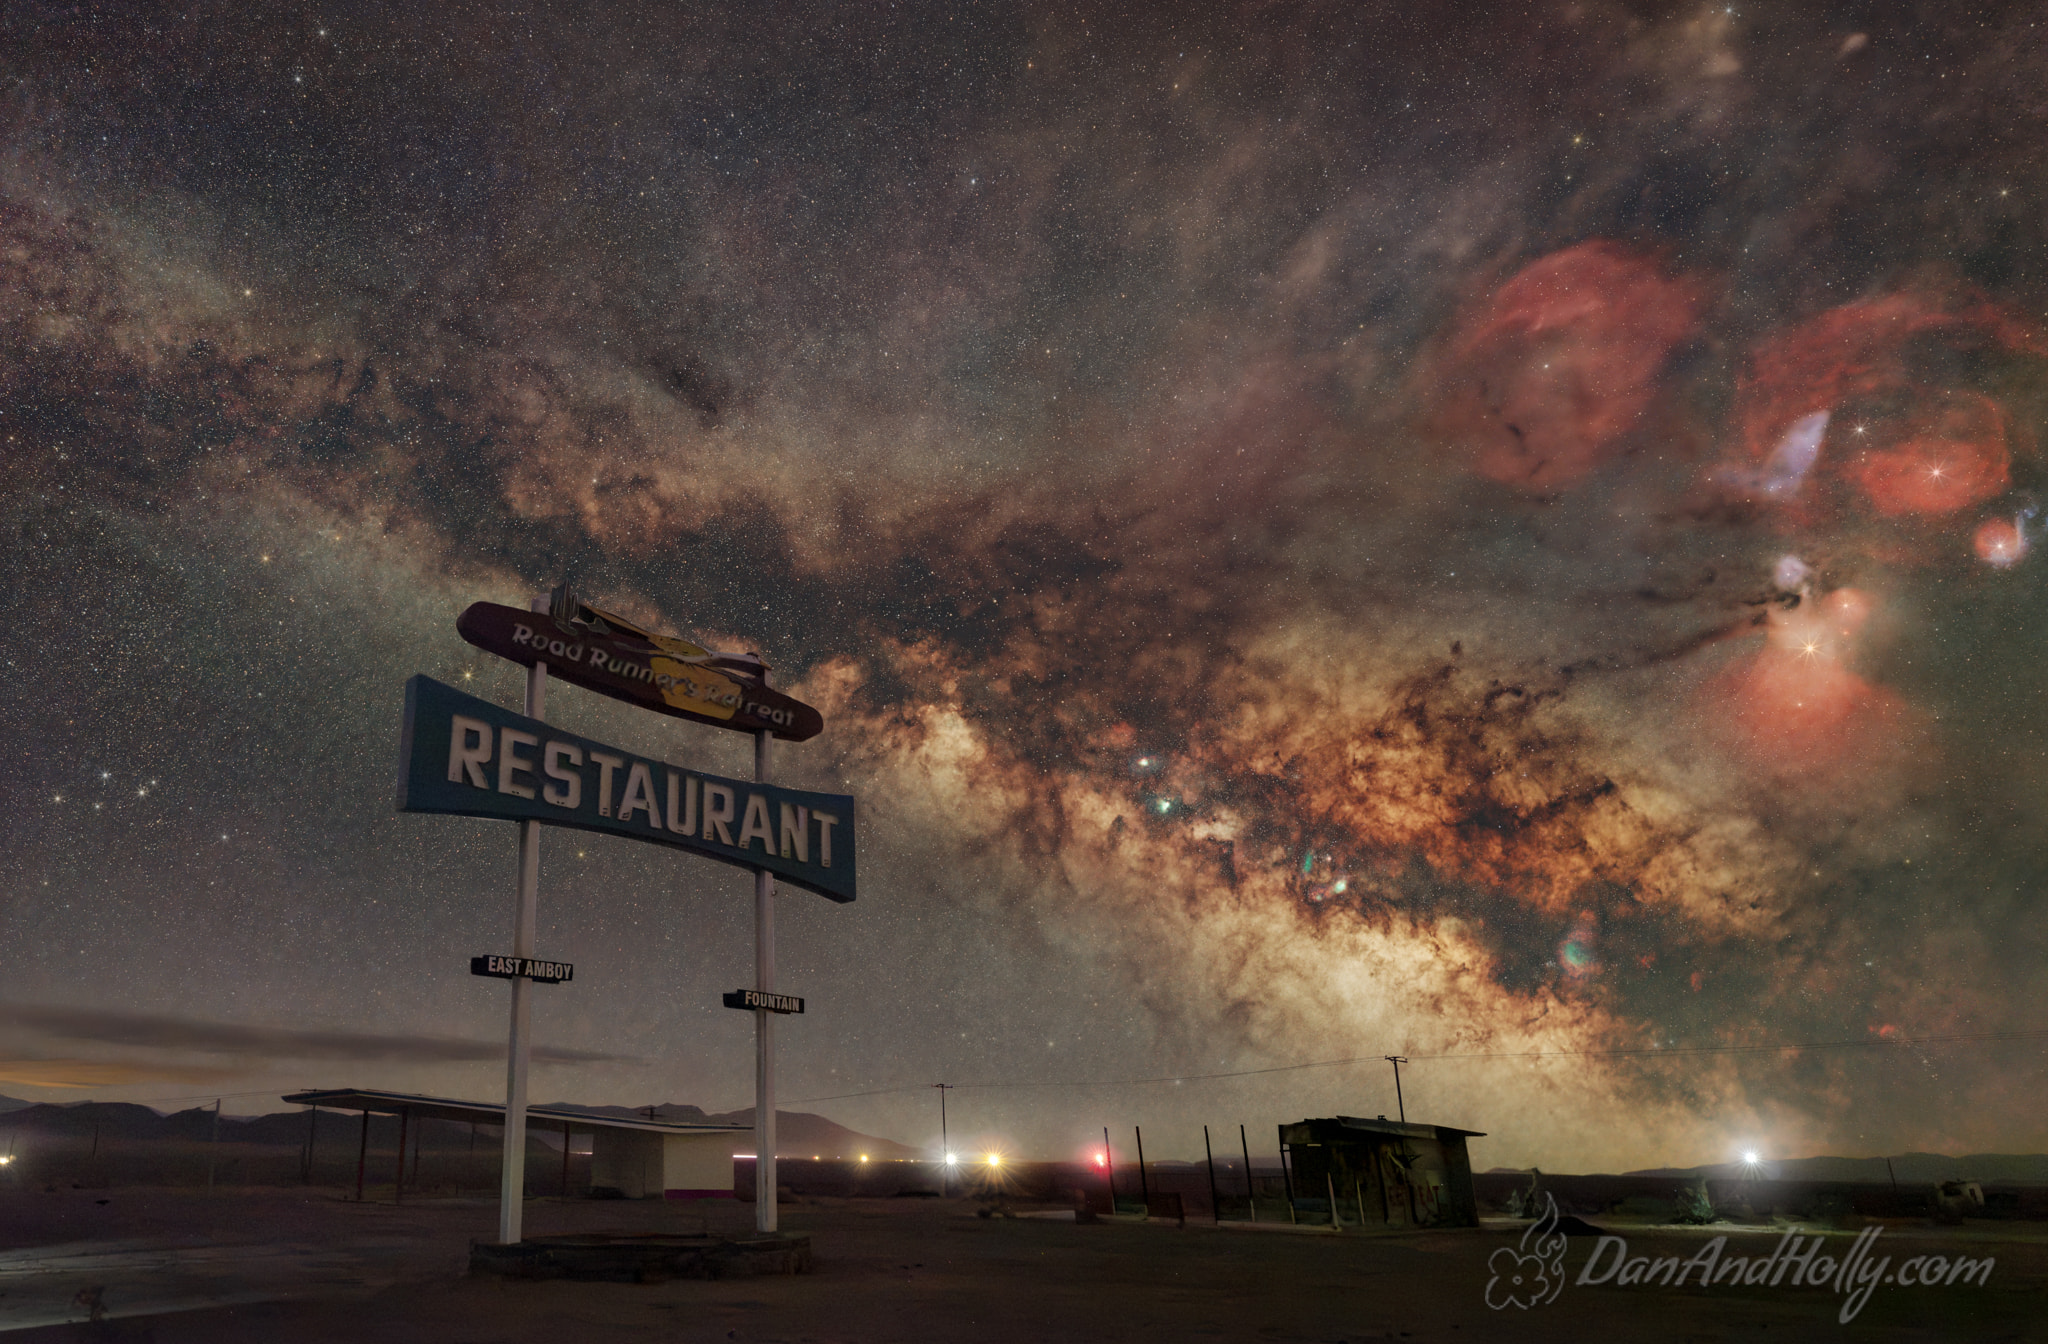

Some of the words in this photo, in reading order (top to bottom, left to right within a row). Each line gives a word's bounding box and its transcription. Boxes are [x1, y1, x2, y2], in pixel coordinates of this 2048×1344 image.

[512, 623, 583, 662] Road
[589, 646, 700, 698] Runner's
[703, 684, 795, 728] Retreat
[447, 714, 839, 869] RESTAURANT
[488, 956, 522, 976] EAST
[525, 960, 573, 981] AMBOY
[745, 991, 800, 1013] FOUNTAIN
